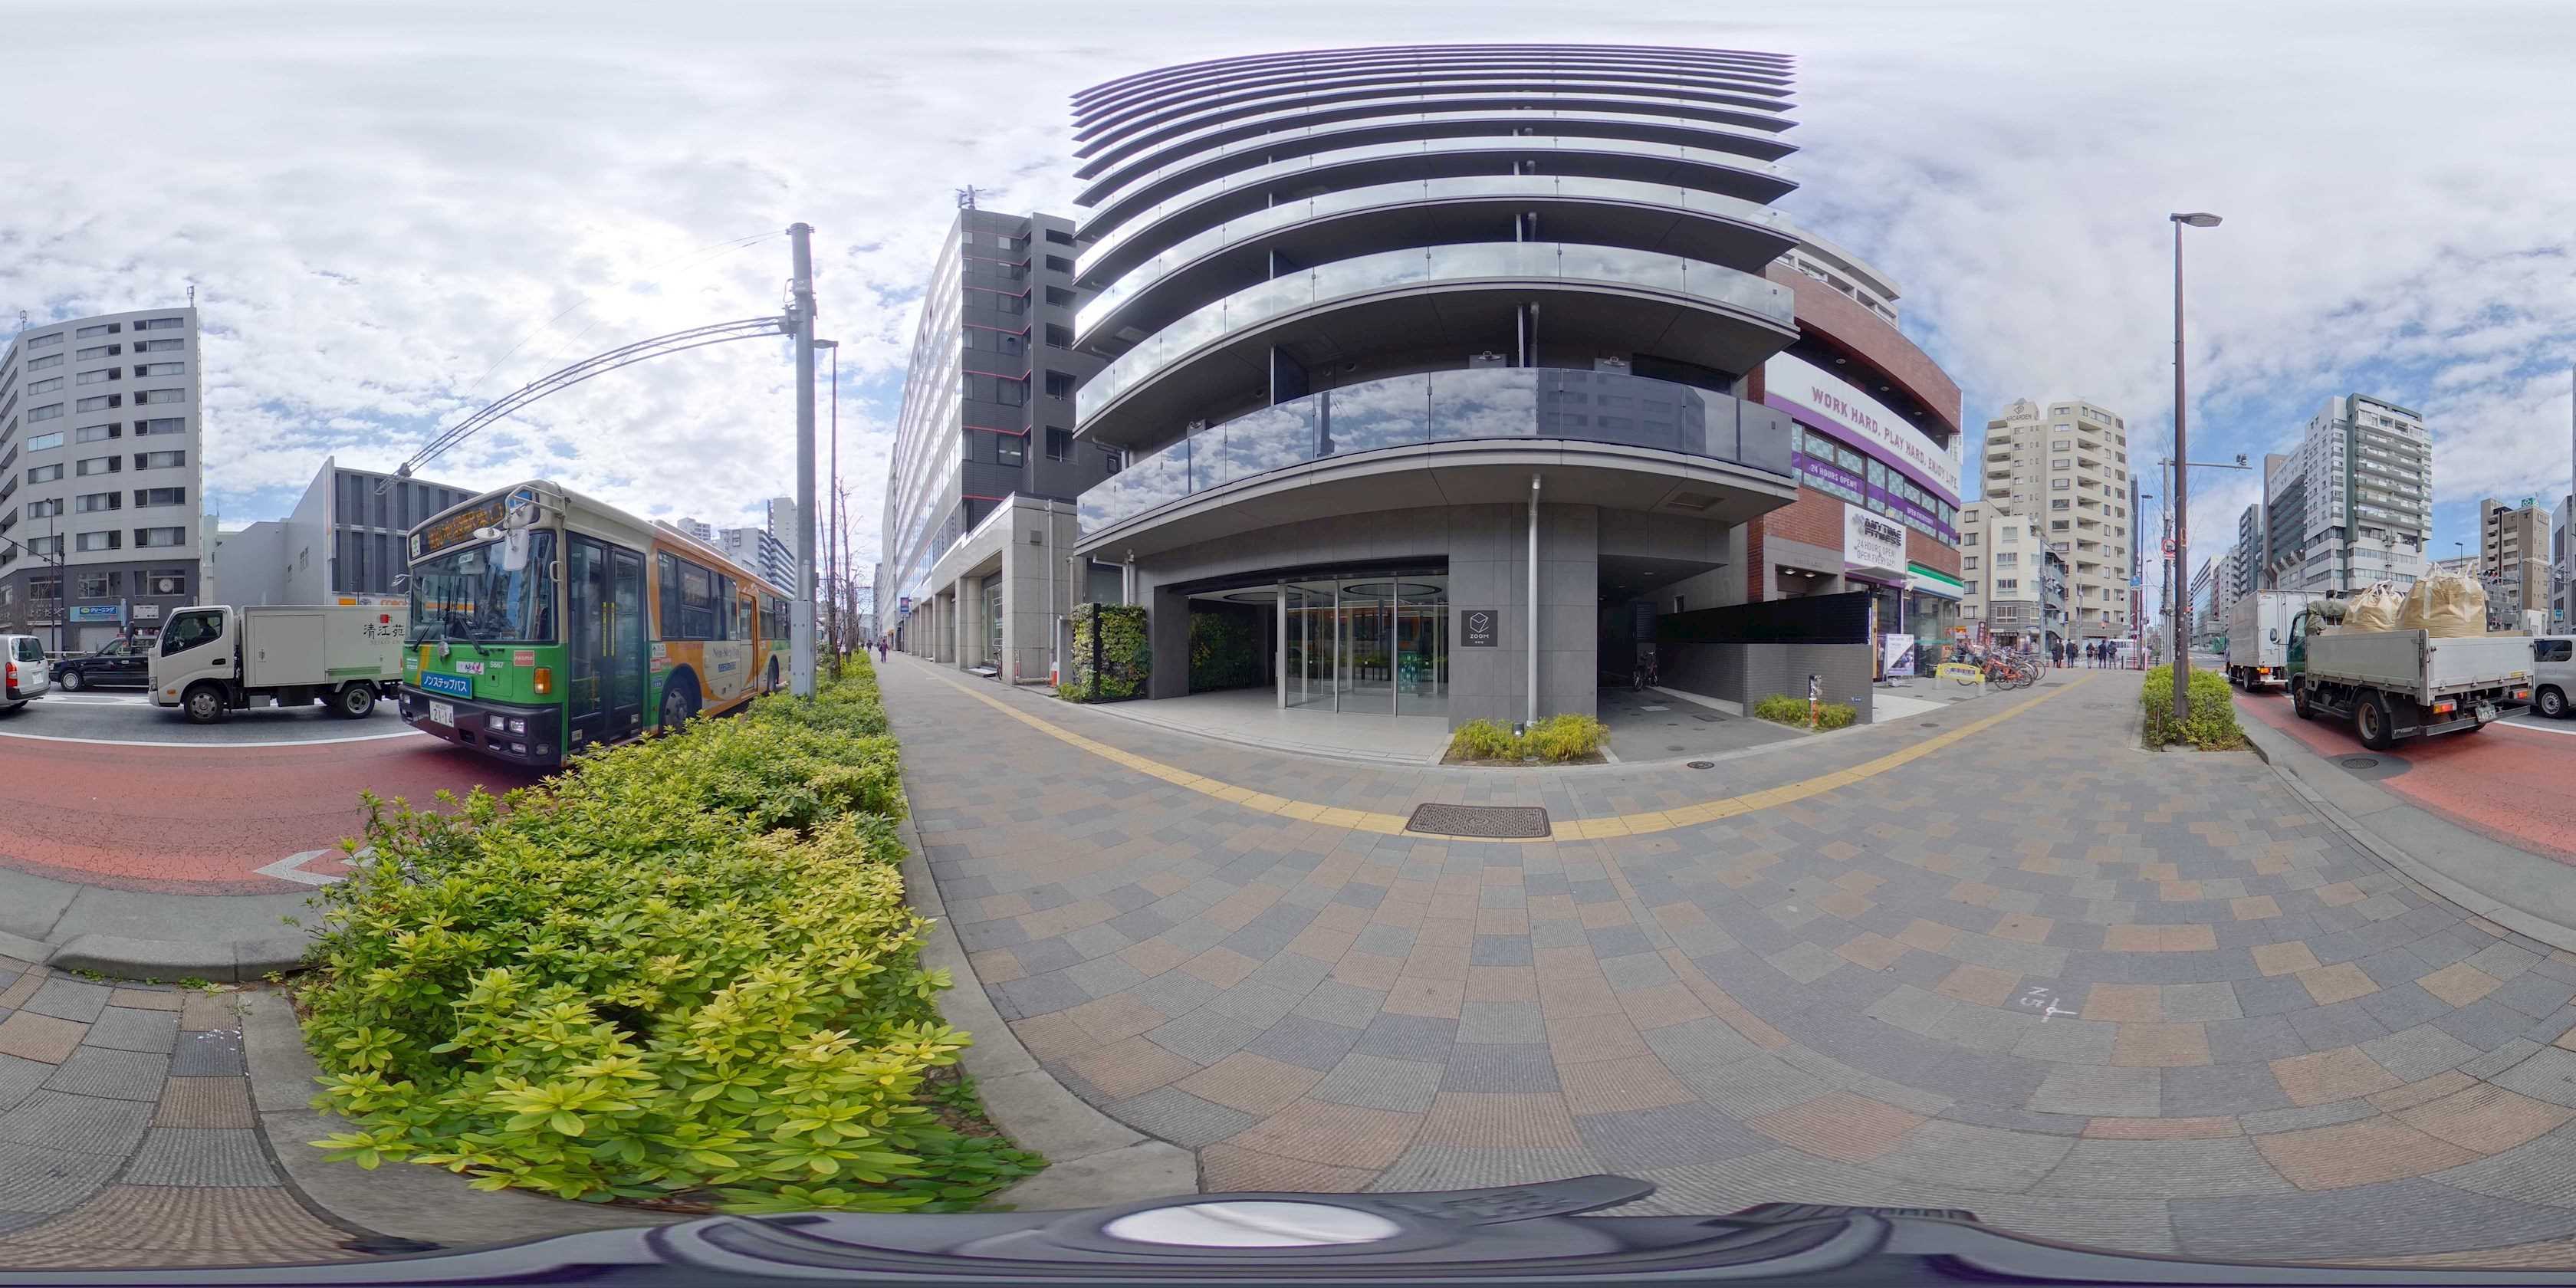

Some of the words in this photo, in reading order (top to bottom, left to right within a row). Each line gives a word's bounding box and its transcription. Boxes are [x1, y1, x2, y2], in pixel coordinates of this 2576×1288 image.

[1811, 386, 1848, 418] WORK
[1851, 406, 1881, 436] HARD.
[1884, 427, 1904, 450] PLAY
[1906, 441, 1927, 467] HARD.
[1928, 457, 1945, 478] ENJOY
[1810, 464, 1819, 473] 24
[1819, 466, 1838, 481] HOURS
[1864, 518, 1902, 539] ANYTIME
[1865, 527, 1902, 547] FITNESS
[363, 623, 406, 639] 清江苑
[423, 675, 467, 692] ノンステップバス
[433, 708, 453, 724] 21-14
